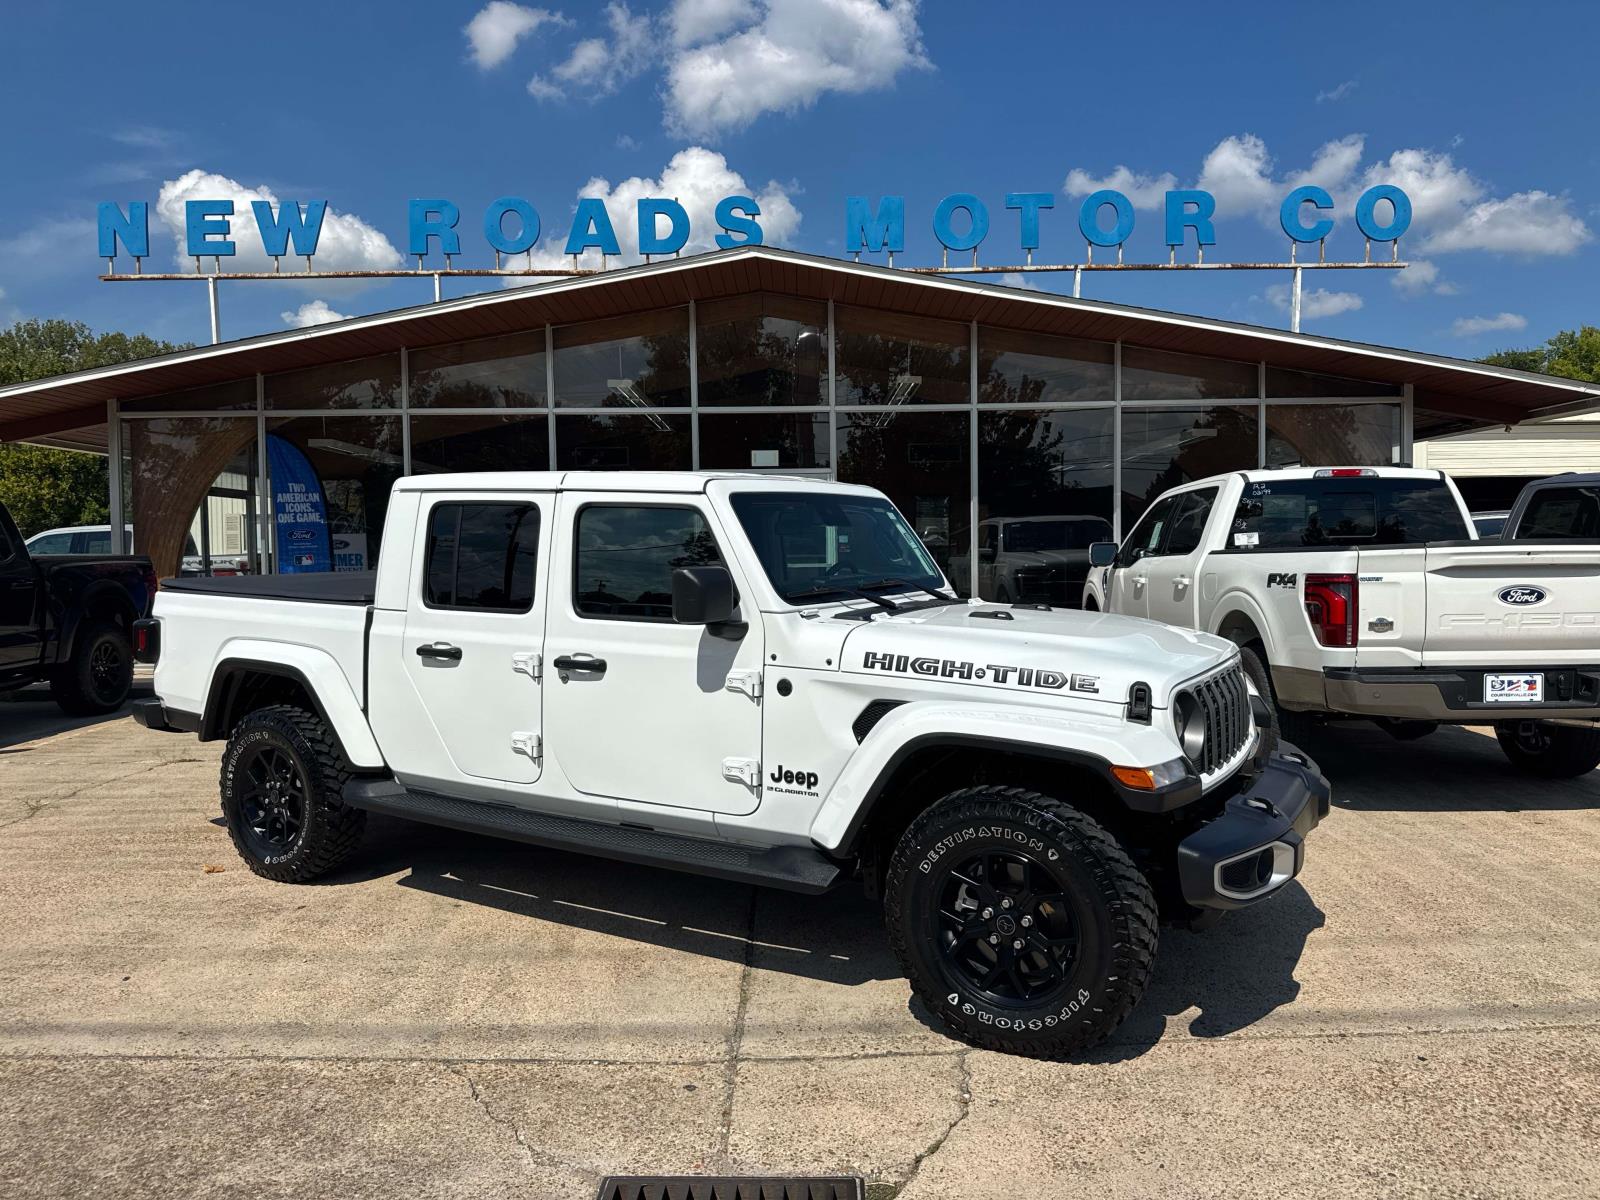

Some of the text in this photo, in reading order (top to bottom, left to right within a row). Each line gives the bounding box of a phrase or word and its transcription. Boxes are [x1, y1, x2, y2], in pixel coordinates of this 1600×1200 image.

[99, 184, 1413, 258] NEW ROADS MOTOR CO
[287, 482, 306, 493] TWO
[276, 492, 320, 503] AMERICAN
[285, 503, 315, 513] ICONS.
[277, 512, 296, 524] ONE
[290, 530, 313, 539] Ford
[1266, 572, 1298, 588] FX4
[1506, 589, 1538, 602] Ford
[863, 651, 1101, 694] HIGH TIDE
[770, 764, 819, 790] Jeep
[774, 786, 819, 798] GLADIATOR
[919, 826, 1044, 874] DESTINATION
